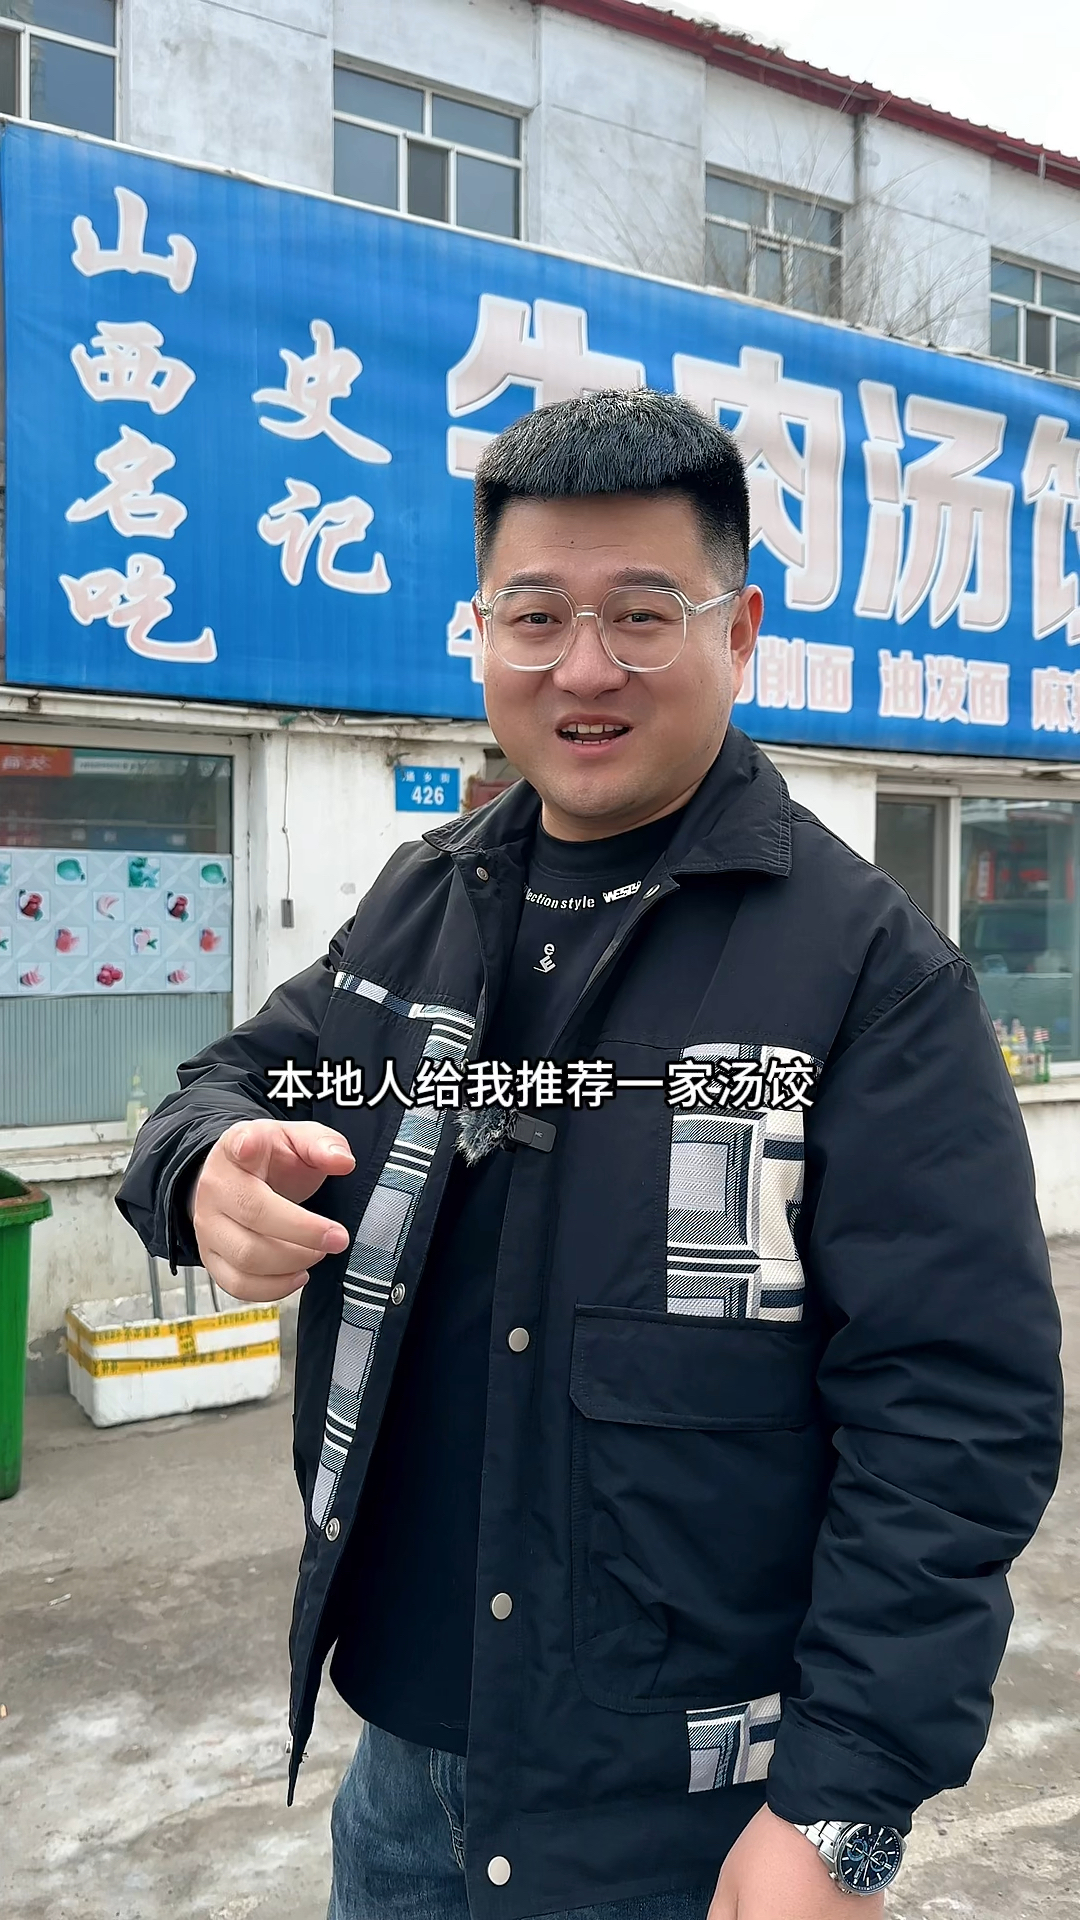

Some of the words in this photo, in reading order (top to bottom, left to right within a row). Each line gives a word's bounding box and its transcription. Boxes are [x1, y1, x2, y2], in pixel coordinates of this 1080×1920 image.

[60, 186, 218, 664] 山西名吃
[252, 318, 392, 594] 史记
[878, 648, 1010, 726] 油泼面
[1032, 666, 1080, 734] 麻
[411, 785, 445, 806] 426
[560, 895, 595, 911] style
